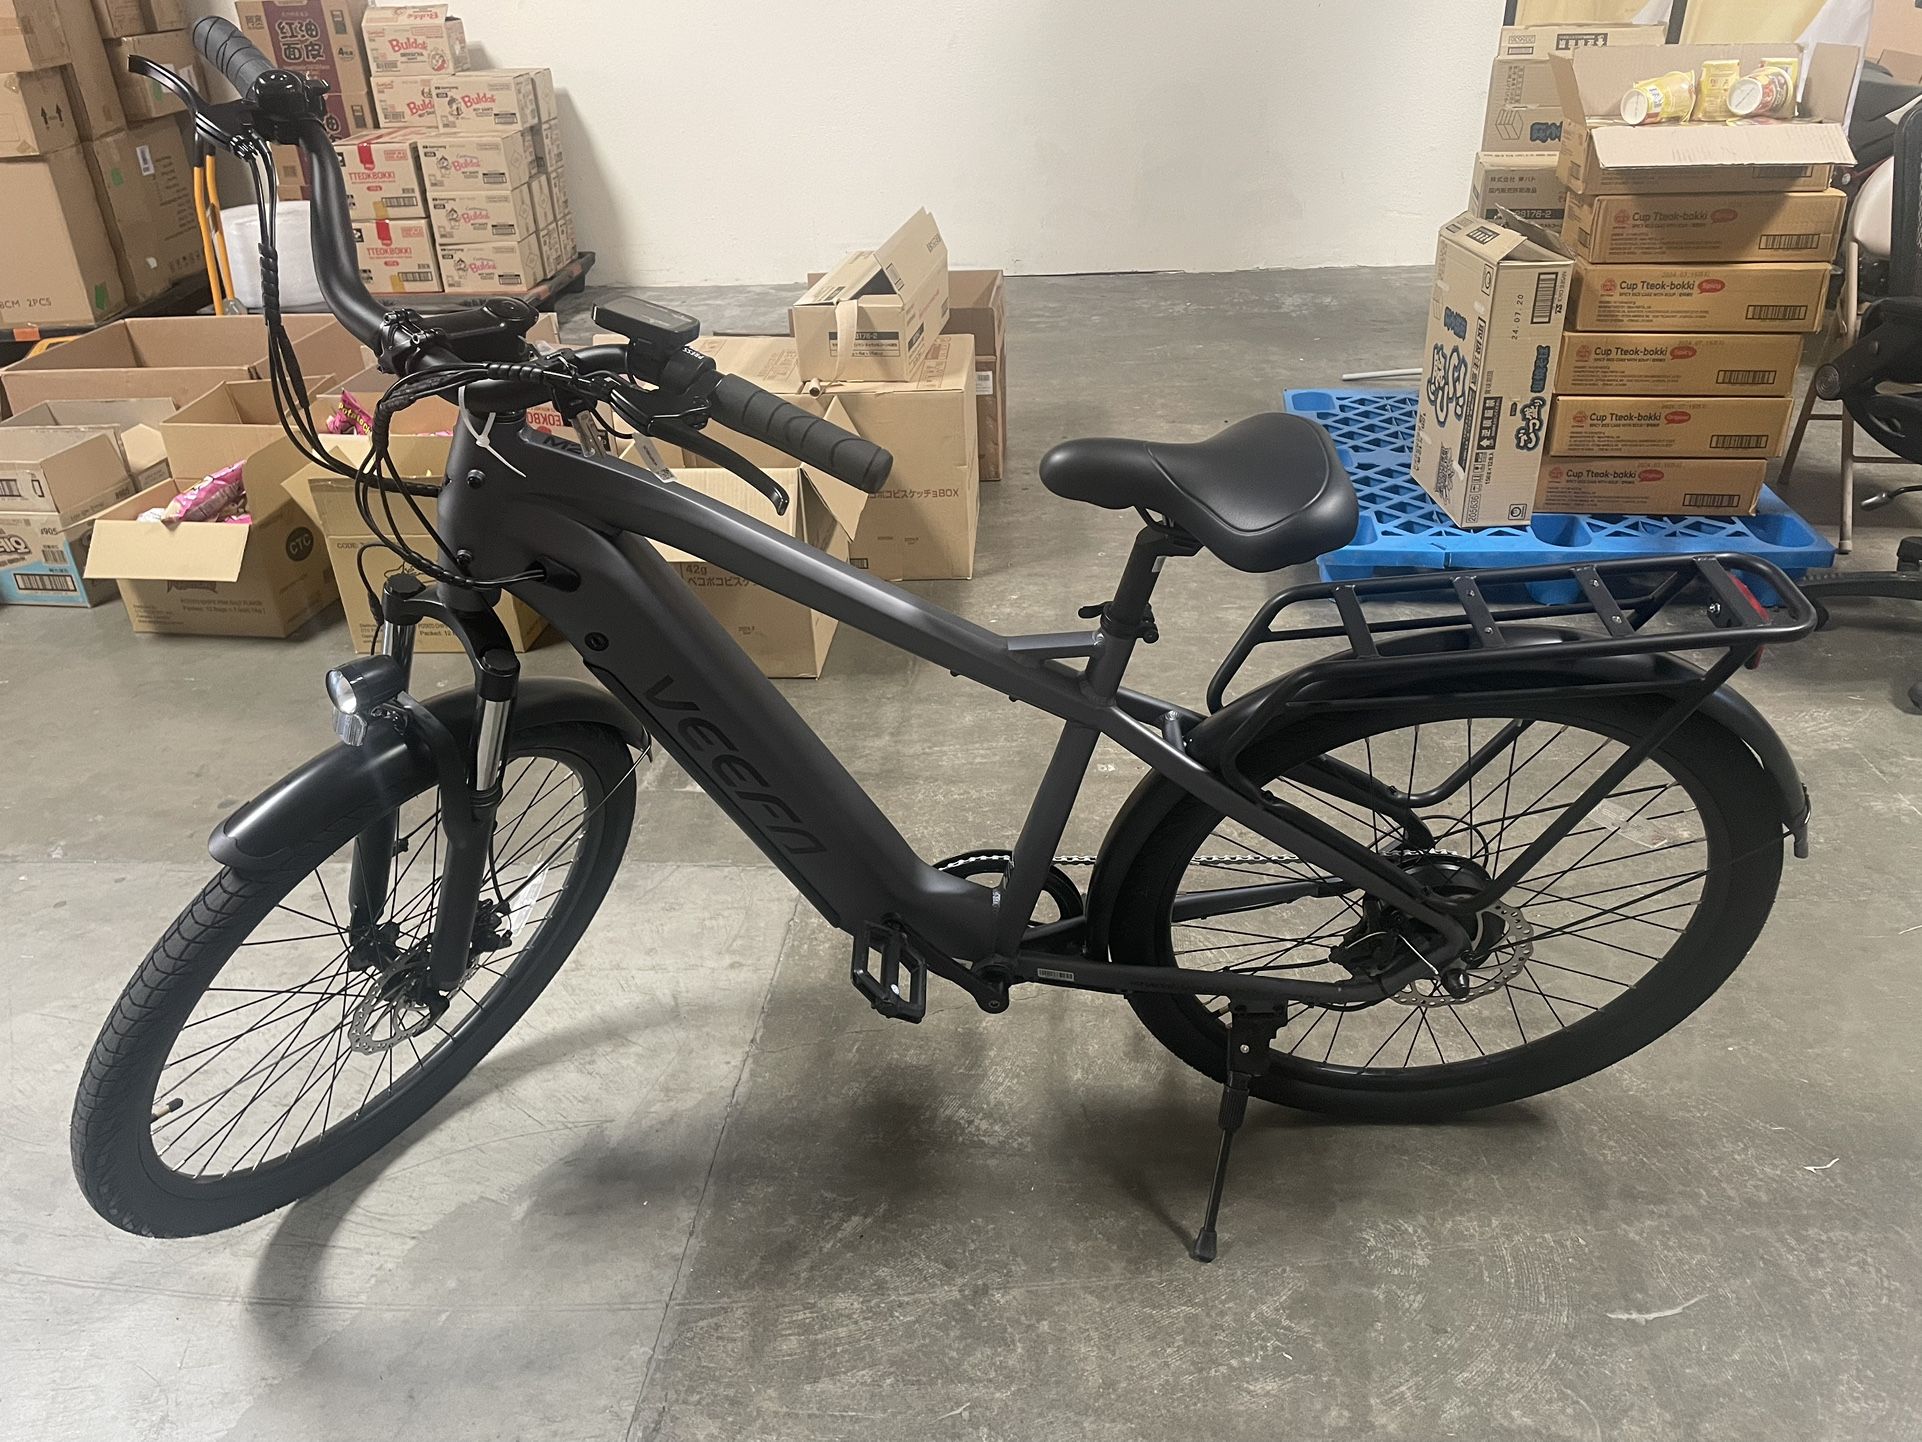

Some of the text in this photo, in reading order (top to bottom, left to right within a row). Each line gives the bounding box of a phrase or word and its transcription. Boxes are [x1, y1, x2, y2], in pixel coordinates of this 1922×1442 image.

[276, 19, 320, 40] 红油
[282, 41, 325, 62] 面皮
[407, 100, 434, 116] Buld
[1632, 212, 1650, 222] Cup
[1619, 280, 1695, 291] Cup Tteok-bokki
[1512, 294, 1524, 340] 24.07.20
[1594, 346, 1668, 357] Cup Tteok-bokki
[526, 410, 562, 427] EOKBO
[1589, 412, 1662, 423] Cup Tteok-bokki
[1566, 469, 1637, 479] Cup Tteok-bokki
[869, 488, 960, 499] コポコビスケッチョBOX
[686, 564, 707, 575] 42g
[688, 576, 751, 587] ペコポコビスケ
